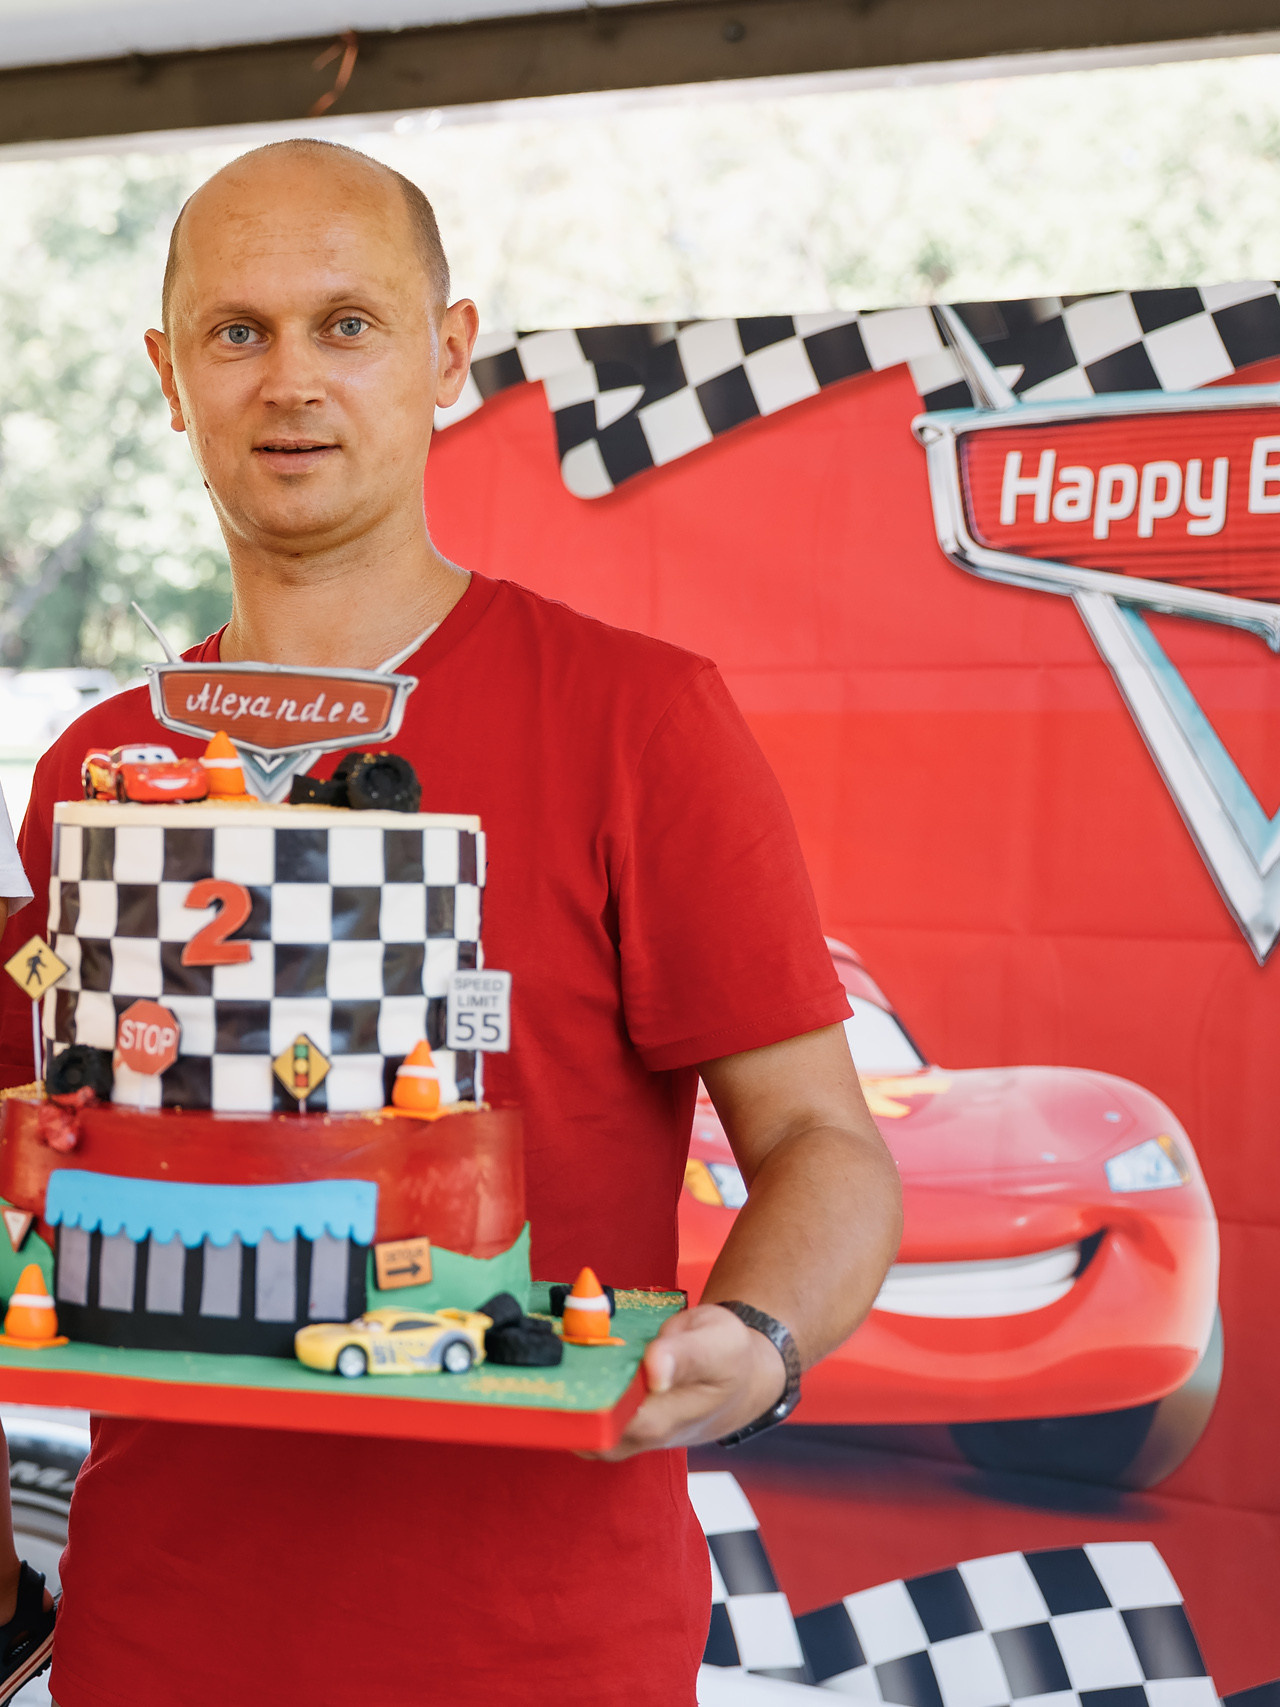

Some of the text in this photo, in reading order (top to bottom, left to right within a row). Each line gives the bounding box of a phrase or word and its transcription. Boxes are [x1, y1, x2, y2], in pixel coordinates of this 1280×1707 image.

[1000, 449, 1229, 539] Happy
[181, 878, 252, 966] 2
[454, 978, 503, 991] SPEED
[457, 995, 498, 1008] LIMIT
[119, 1019, 176, 1055] STOP
[455, 1012, 500, 1042] 55
